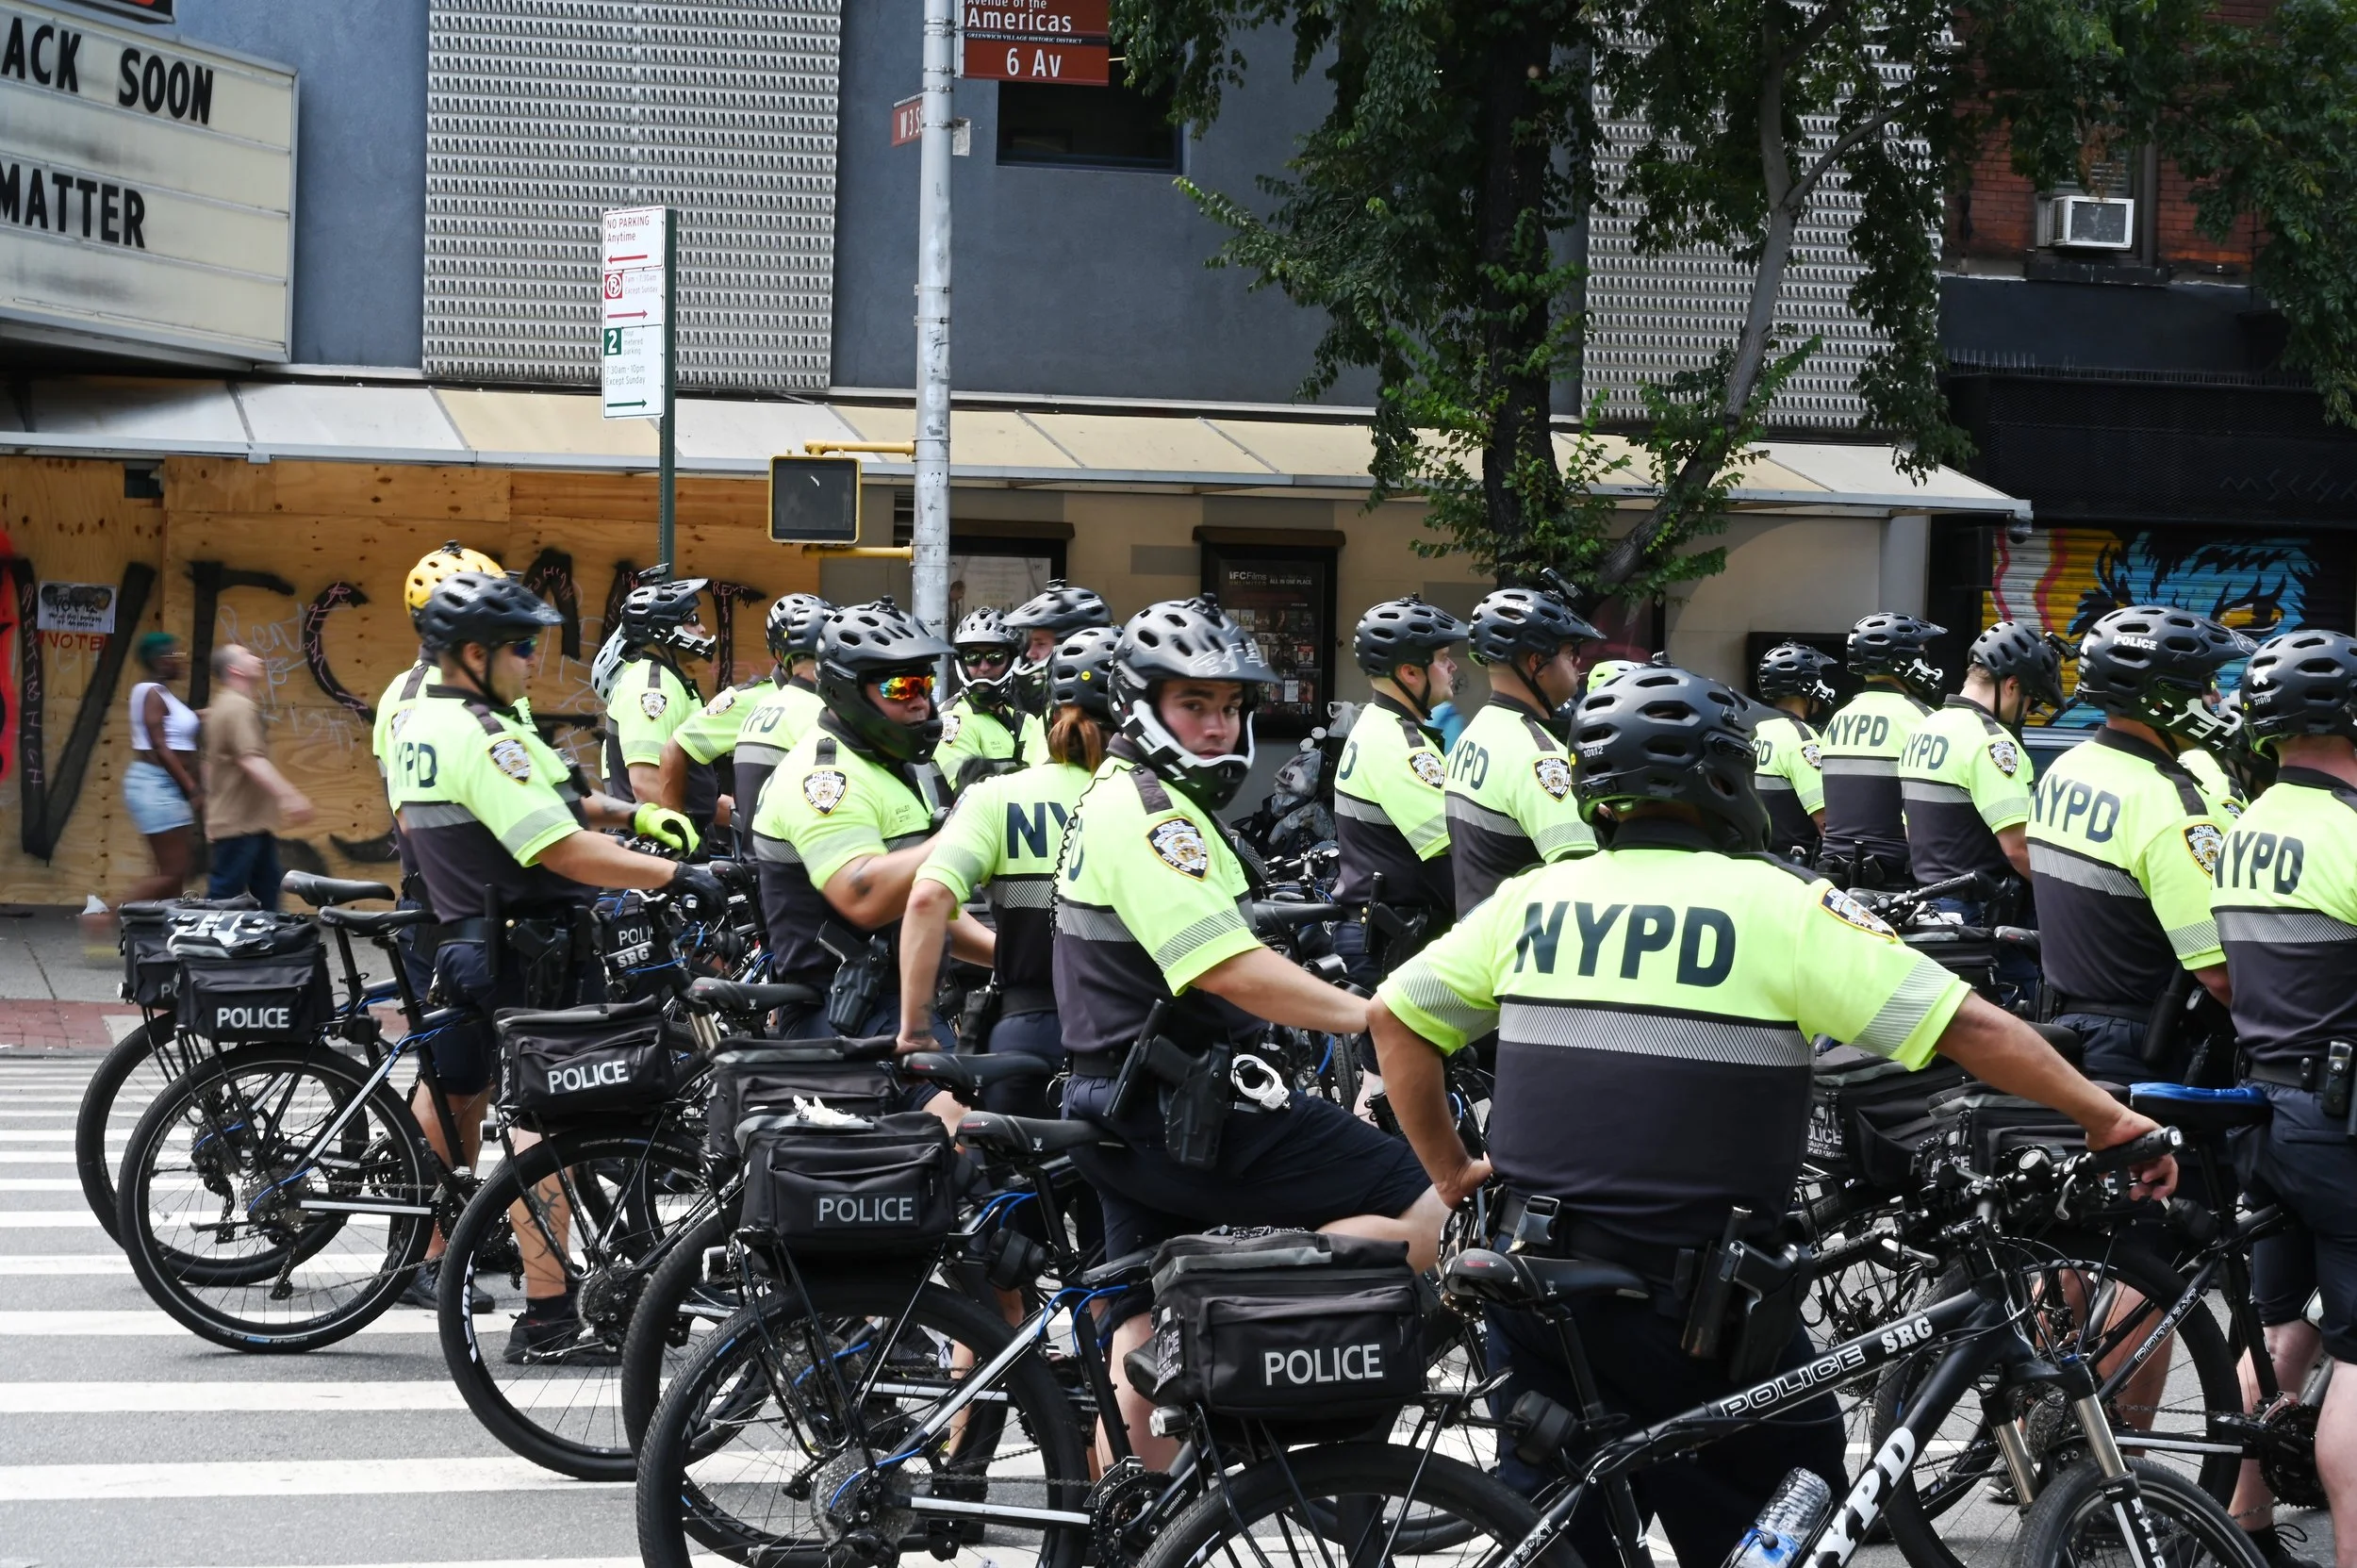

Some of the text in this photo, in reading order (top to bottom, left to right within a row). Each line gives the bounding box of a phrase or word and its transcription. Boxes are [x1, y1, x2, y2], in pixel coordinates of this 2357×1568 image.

[966, 8, 1072, 33] Americas
[1, 16, 214, 125] ACK SOON
[1006, 47, 1062, 77] 6 Av
[909, 108, 914, 136] 3
[0, 161, 145, 249] MATTER
[607, 215, 650, 229] NO PARKING
[607, 233, 636, 244] Anytime
[607, 329, 618, 355] 2
[606, 376, 646, 387] Except Sunday
[2113, 635, 2158, 651] POLICE
[2254, 695, 2271, 706] 31919
[1827, 714, 1889, 747] NYPD
[1446, 738, 1490, 790] YPD
[1583, 746, 1604, 758] 10112
[2193, 825, 2214, 834] POLICE
[2192, 850, 2203, 864] CITY
[1514, 900, 1737, 988] NYPD
[216, 1007, 290, 1029] POLICE
[547, 1060, 630, 1095] POLICE
[818, 1197, 914, 1223] POLICE
[1264, 1343, 1384, 1386] POLICE
[1719, 1316, 1933, 1418] POLICE SRG
[1162, 1489, 1187, 1519] SHIMANO
